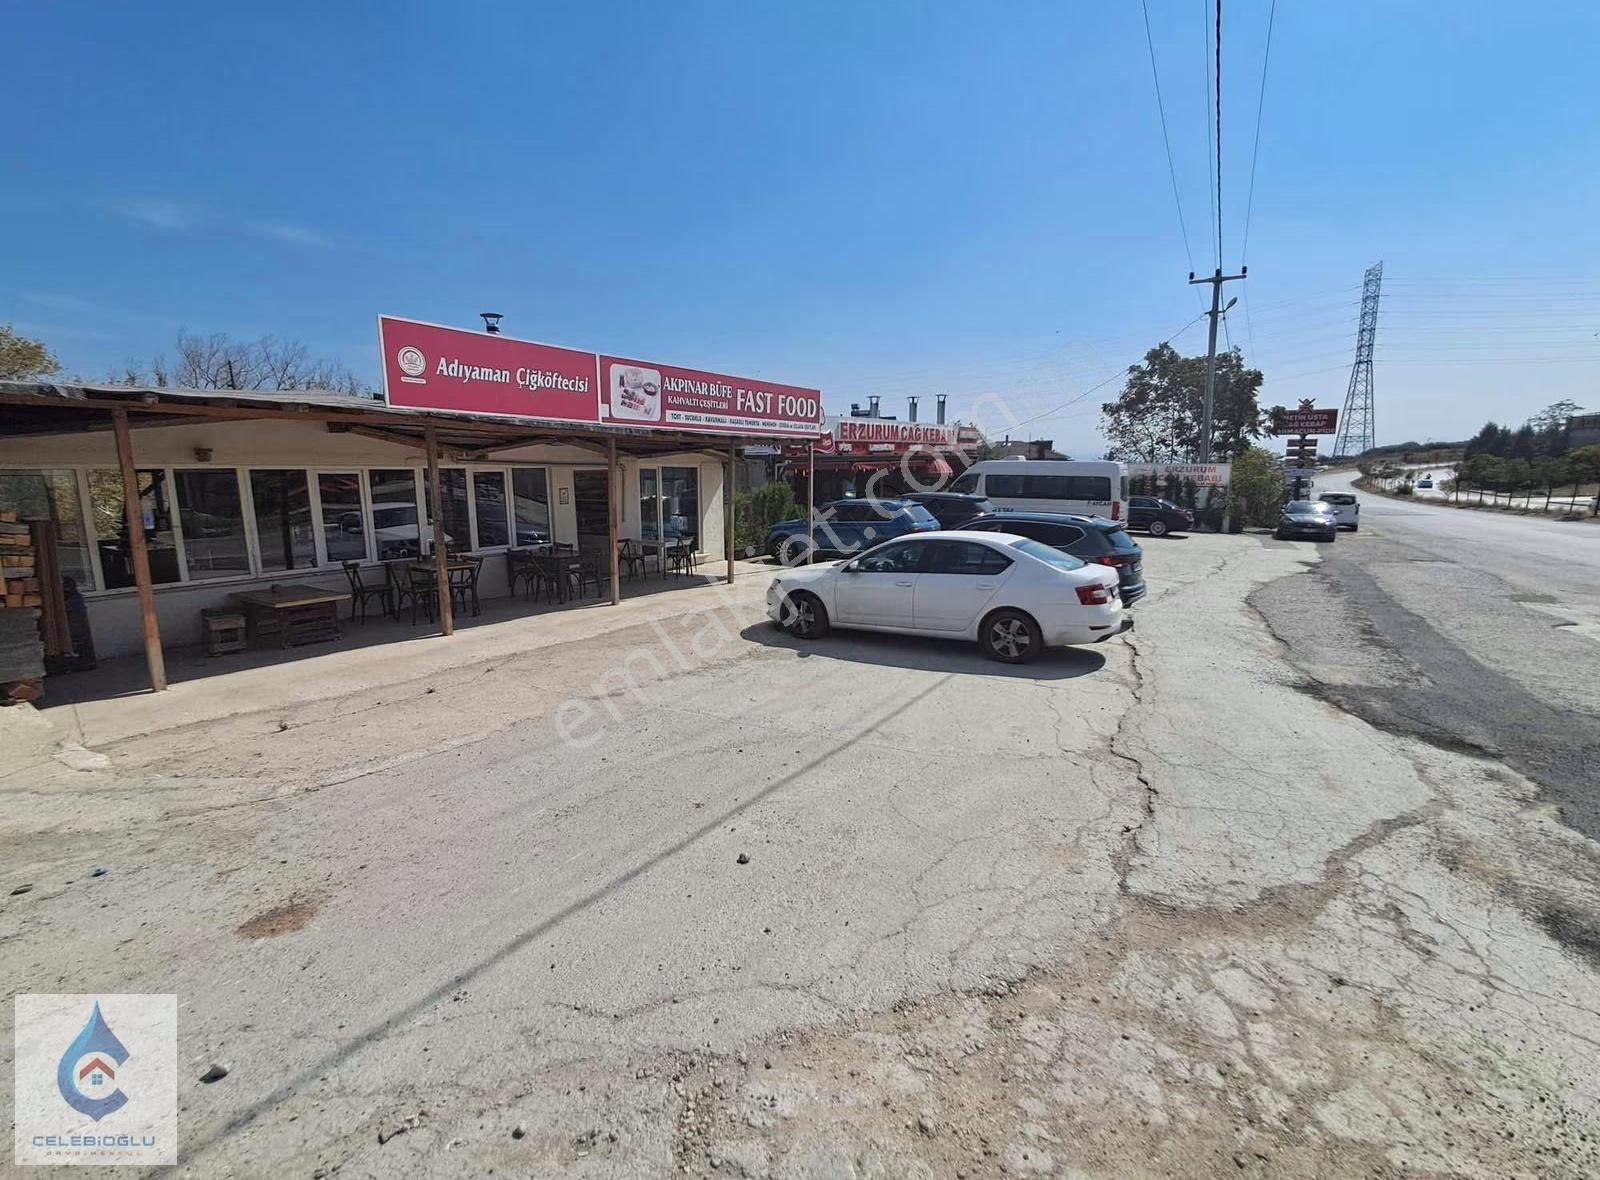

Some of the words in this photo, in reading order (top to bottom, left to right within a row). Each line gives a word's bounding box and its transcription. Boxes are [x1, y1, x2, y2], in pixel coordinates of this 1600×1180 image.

[436, 357, 510, 383] Adıyaman
[516, 368, 589, 393] Çiğköftecisi
[663, 376, 708, 395] AKPINAR
[709, 381, 733, 399] BÜFE
[667, 395, 699, 407] KAHVALTI
[736, 388, 773, 414] FAST
[778, 394, 817, 418] FOOD
[840, 421, 899, 441] ERZURUM
